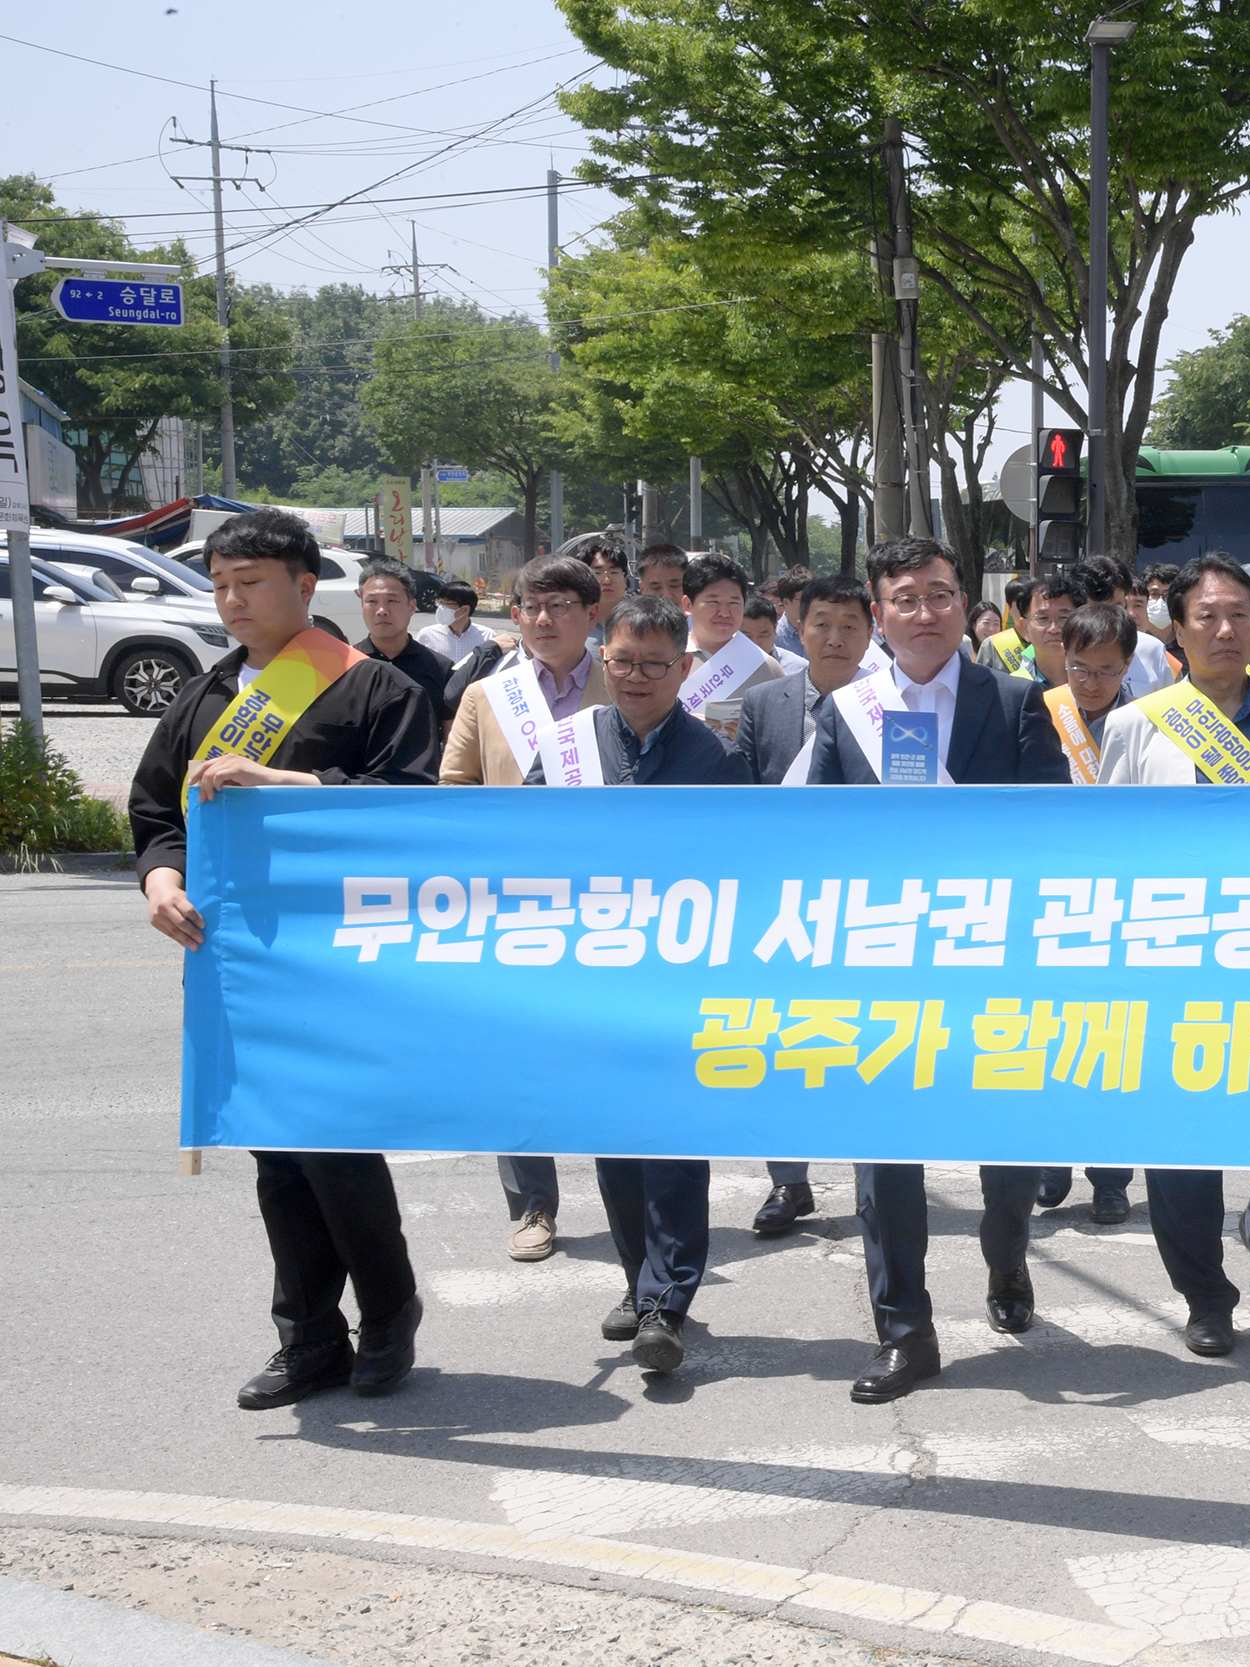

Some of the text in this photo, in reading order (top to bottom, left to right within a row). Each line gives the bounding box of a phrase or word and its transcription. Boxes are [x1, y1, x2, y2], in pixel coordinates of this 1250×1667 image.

[70, 289, 103, 300] 92 2
[108, 306, 177, 320] Seungdal-ro
[120, 286, 176, 306] 승달로
[219, 688, 271, 749] 공항이
[502, 677, 530, 717] 관광객
[1057, 703, 1087, 747] 소음에
[1161, 707, 1208, 750] 공항이
[1200, 745, 1224, 768] 될
[333, 875, 739, 967] 무안공항이
[753, 878, 1012, 968] 서남권
[692, 998, 950, 1090] 광주가
[972, 998, 1149, 1092] 함께
